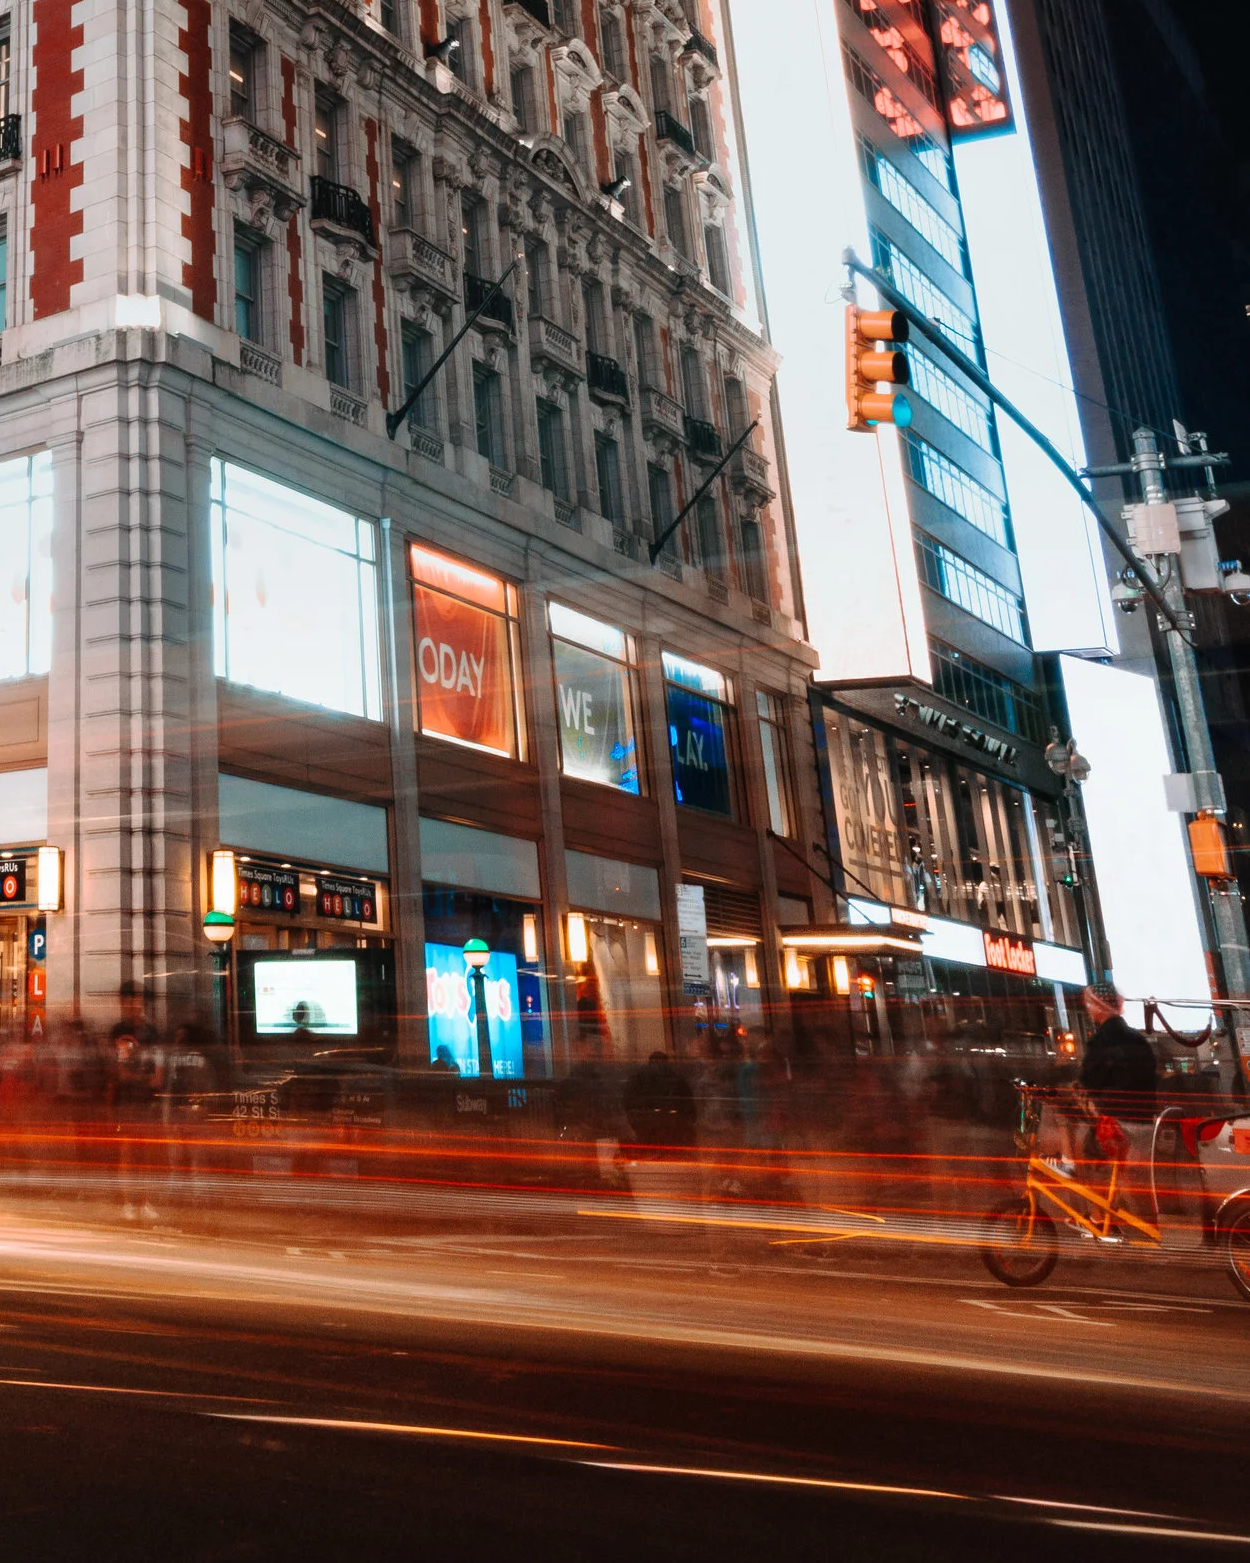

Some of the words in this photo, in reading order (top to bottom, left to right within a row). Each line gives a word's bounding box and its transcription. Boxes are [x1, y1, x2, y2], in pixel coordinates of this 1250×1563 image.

[418, 637, 484, 699] ODAY
[559, 683, 595, 736] WE
[675, 729, 708, 771] LAY.
[238, 867, 253, 879] Times
[253, 870, 272, 882] Square
[234, 1091, 266, 1104] Times
[456, 1094, 487, 1115] Subway
